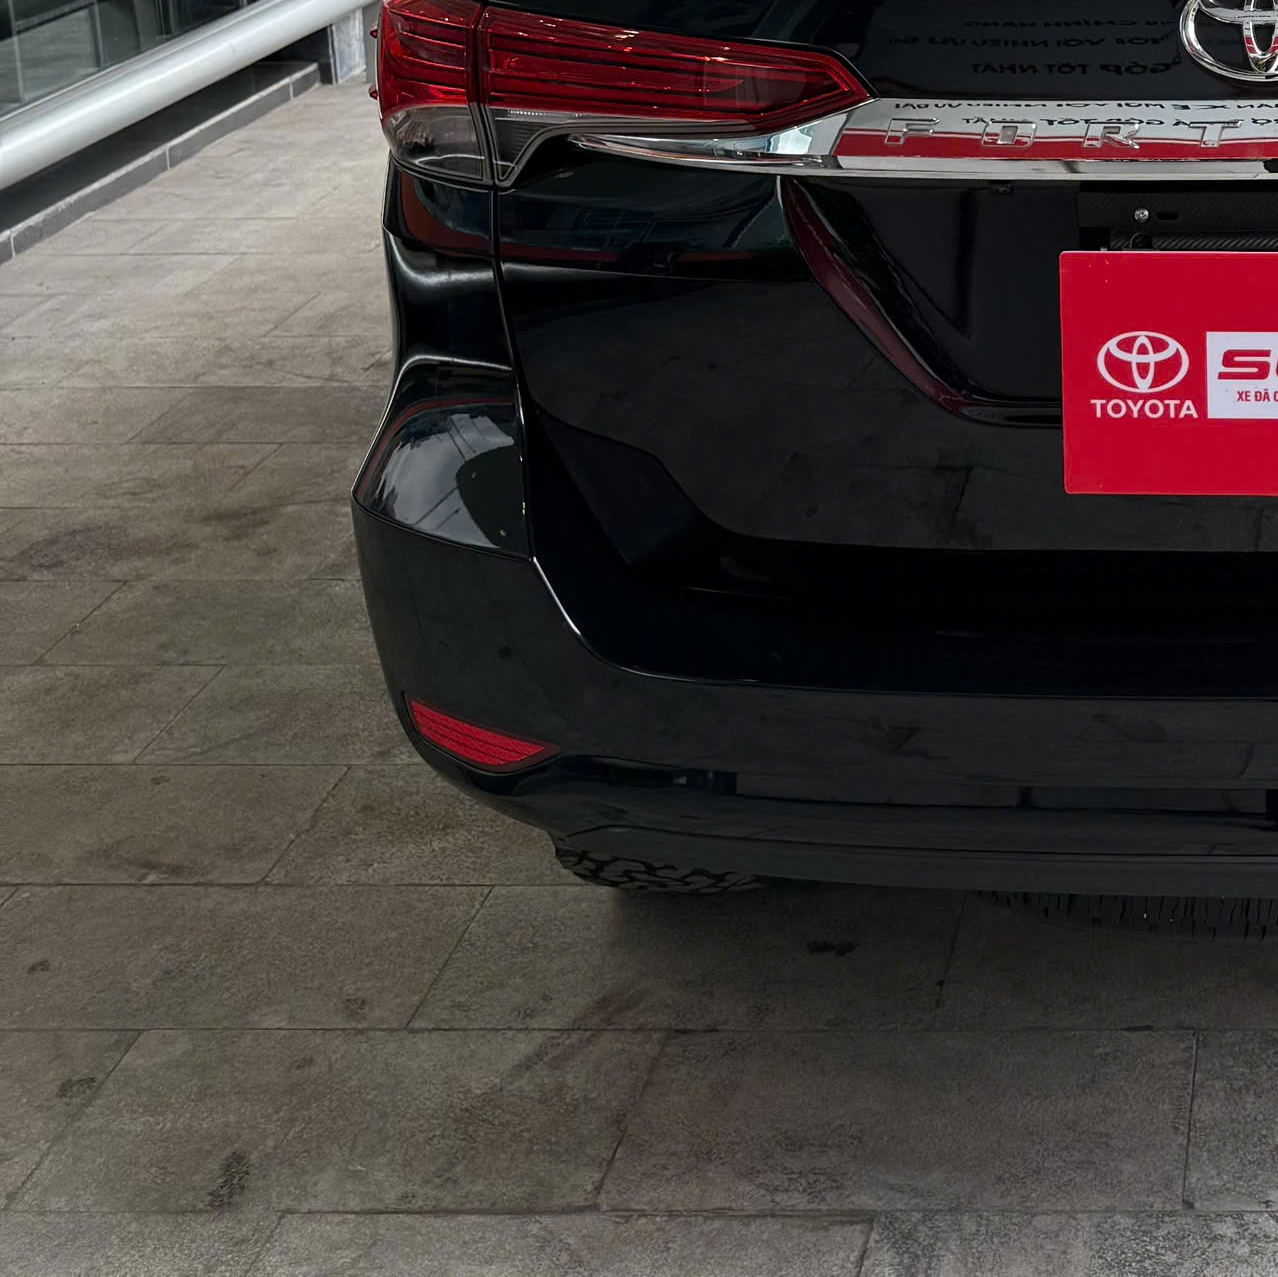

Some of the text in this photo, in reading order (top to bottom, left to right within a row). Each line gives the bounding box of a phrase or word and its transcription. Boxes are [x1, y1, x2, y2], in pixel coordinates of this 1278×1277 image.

[1236, 390, 1251, 402] XE
[1254, 388, 1270, 403] ĐÃ
[1090, 399, 1199, 419] TOYOTA
